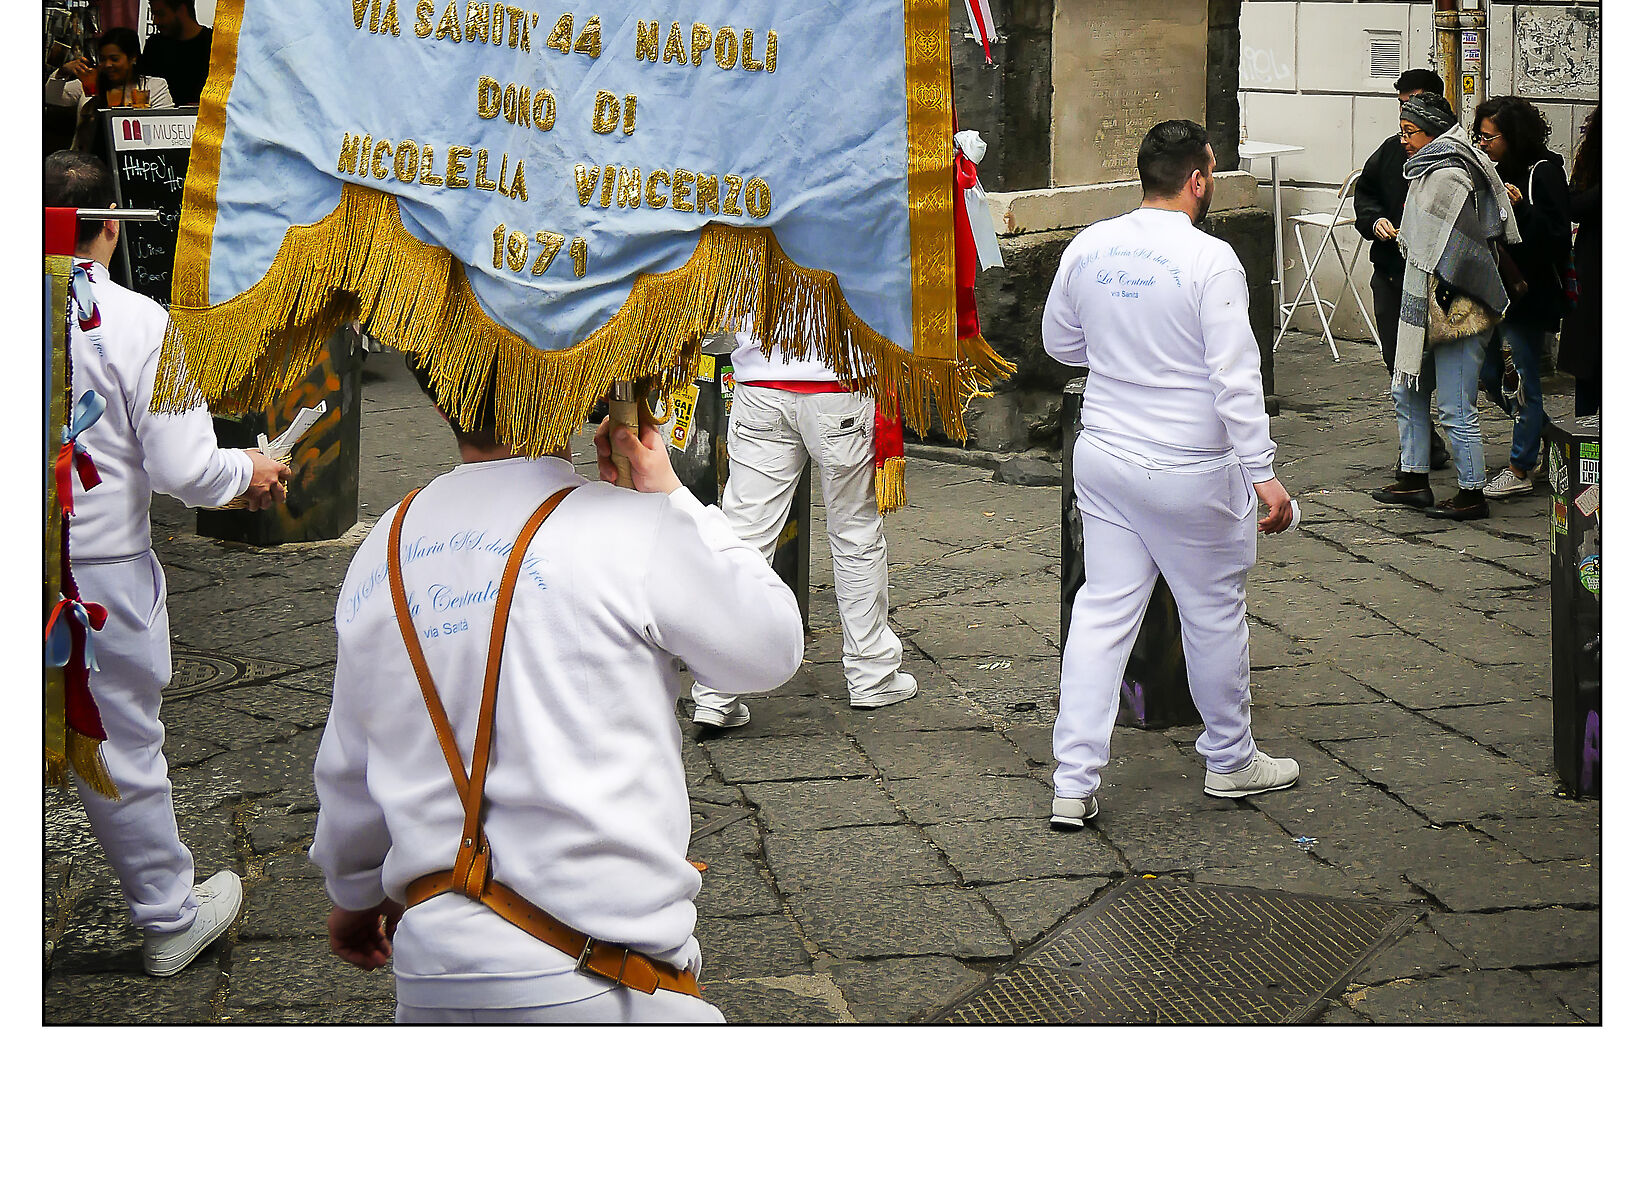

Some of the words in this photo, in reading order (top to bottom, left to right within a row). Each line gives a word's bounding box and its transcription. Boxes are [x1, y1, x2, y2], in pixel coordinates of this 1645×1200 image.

[546, 12, 602, 60] 44
[635, 19, 778, 74] NAPOLI
[154, 124, 195, 141] MUSEU
[477, 75, 558, 133] DONO
[591, 89, 638, 137] DI
[337, 131, 529, 202] NICOLELLA
[574, 163, 772, 220] VINCENZO
[492, 223, 588, 280] 1971
[424, 626, 439, 639] via
